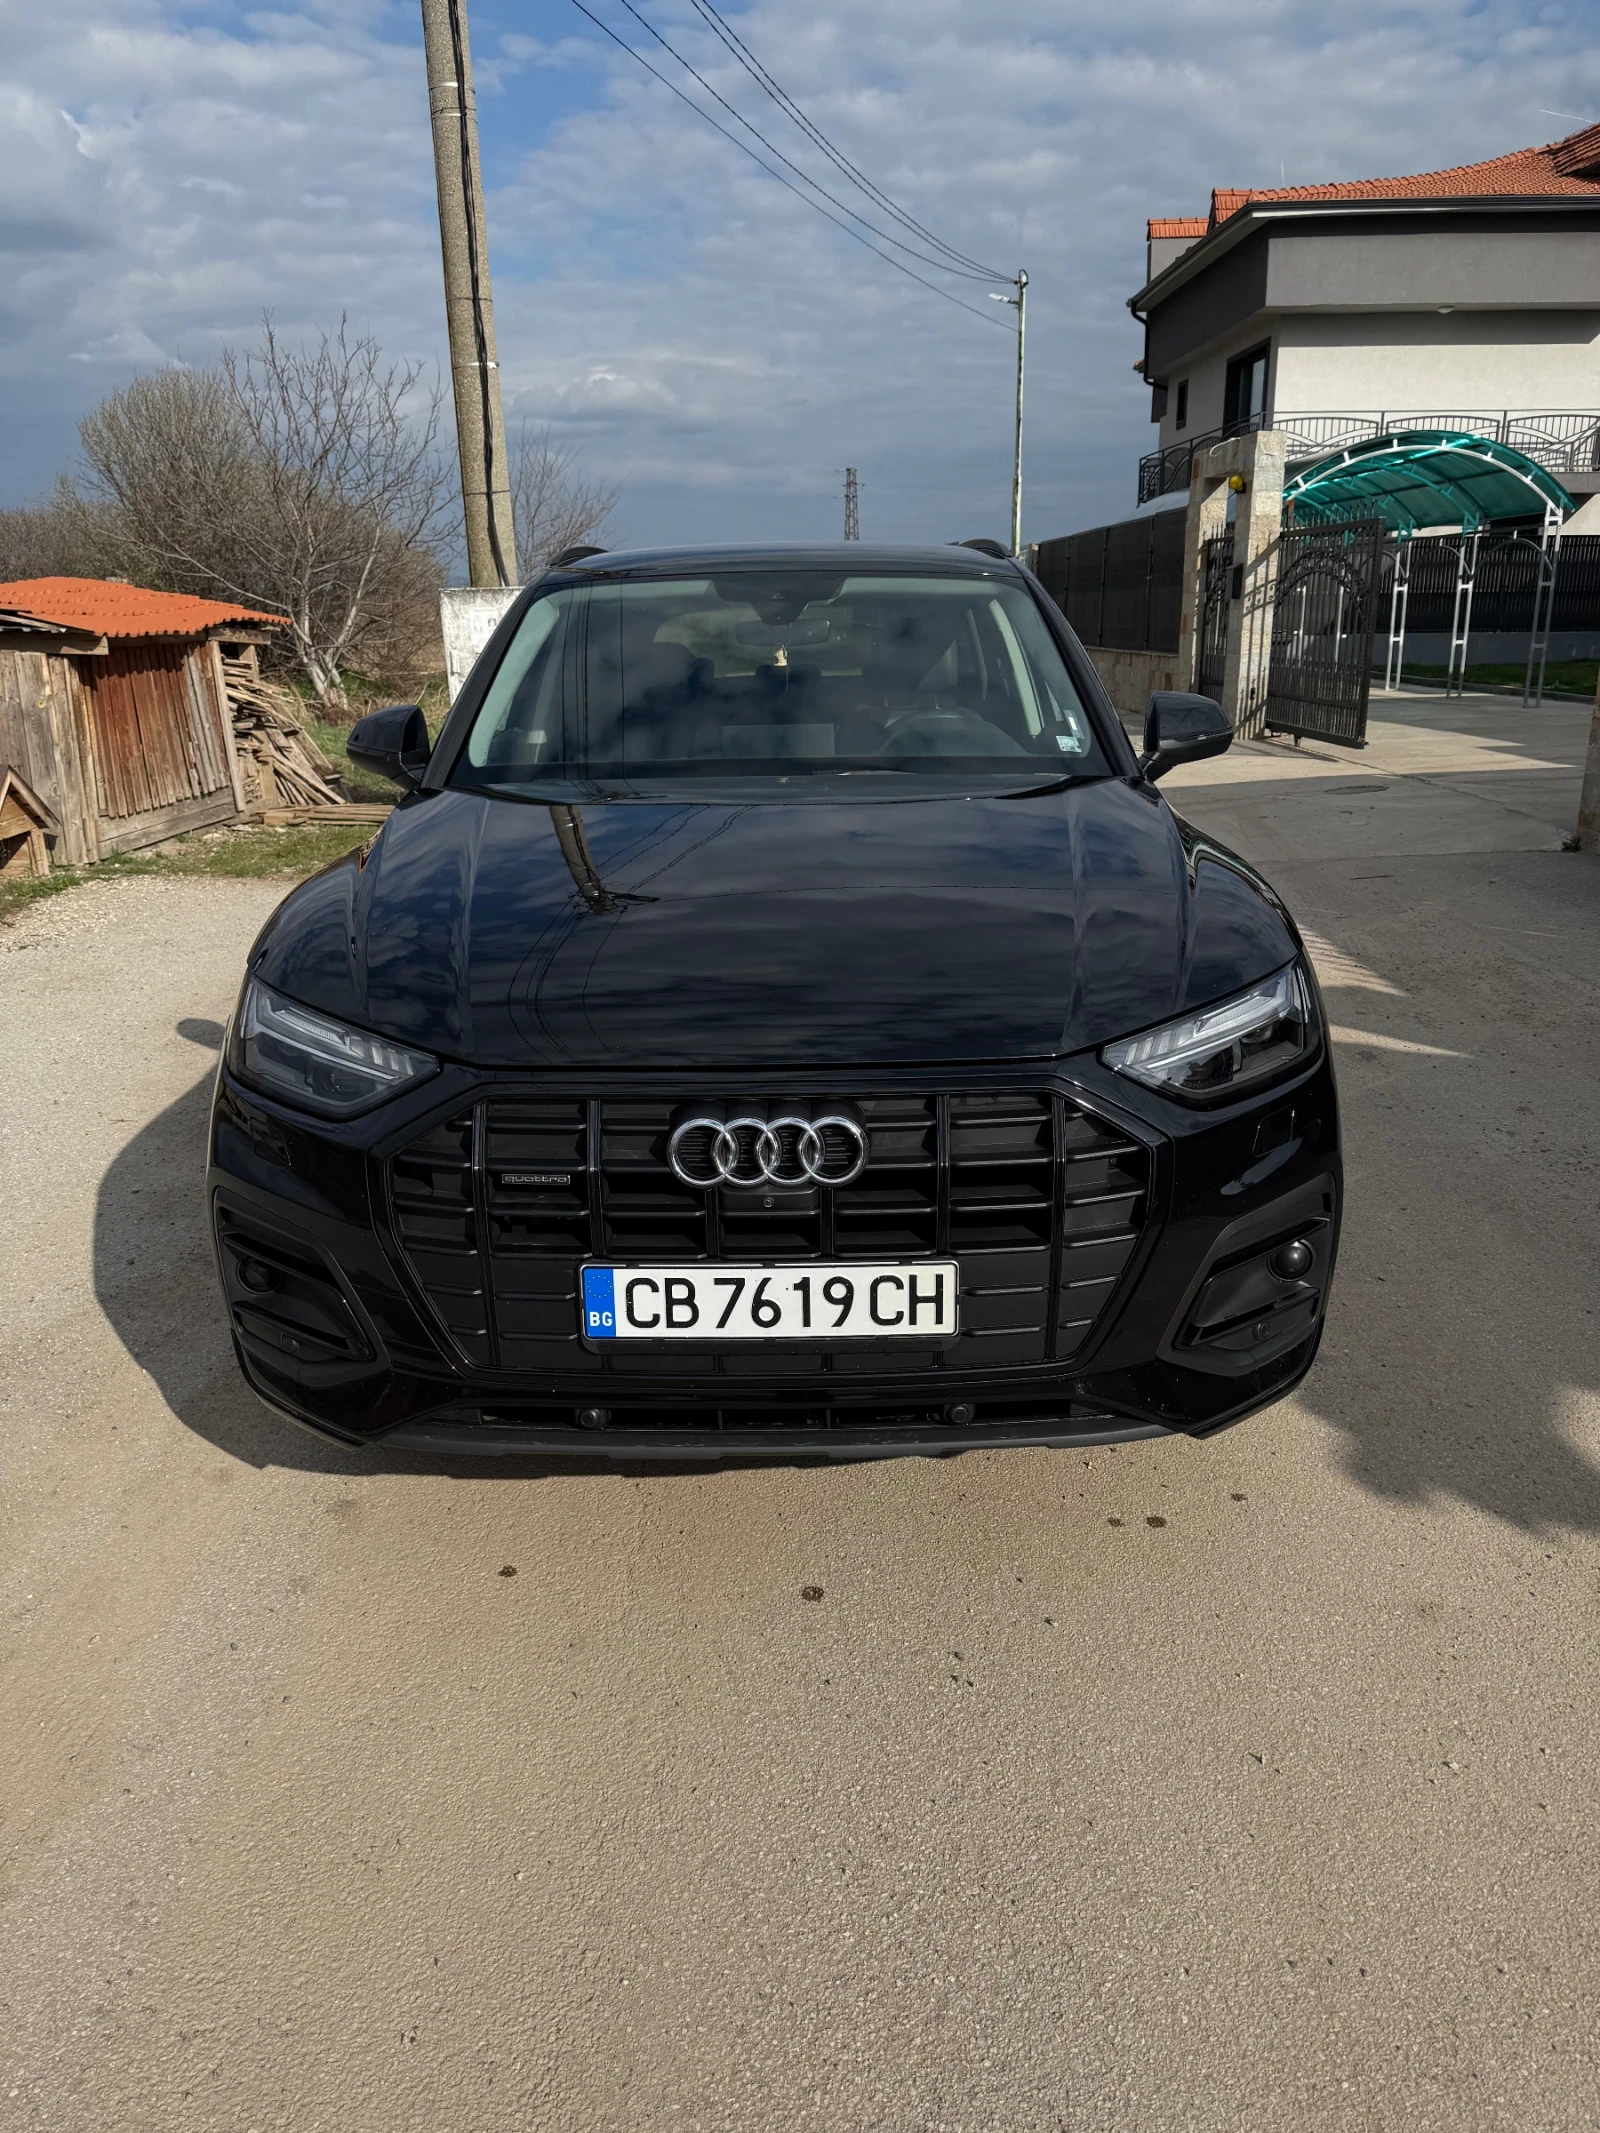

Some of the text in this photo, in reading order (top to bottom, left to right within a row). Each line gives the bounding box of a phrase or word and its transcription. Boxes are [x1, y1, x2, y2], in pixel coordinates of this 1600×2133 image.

[504, 1175, 567, 1183] quattro
[626, 1273, 944, 1329] CB 7619 CH
[589, 1311, 613, 1327] BG
